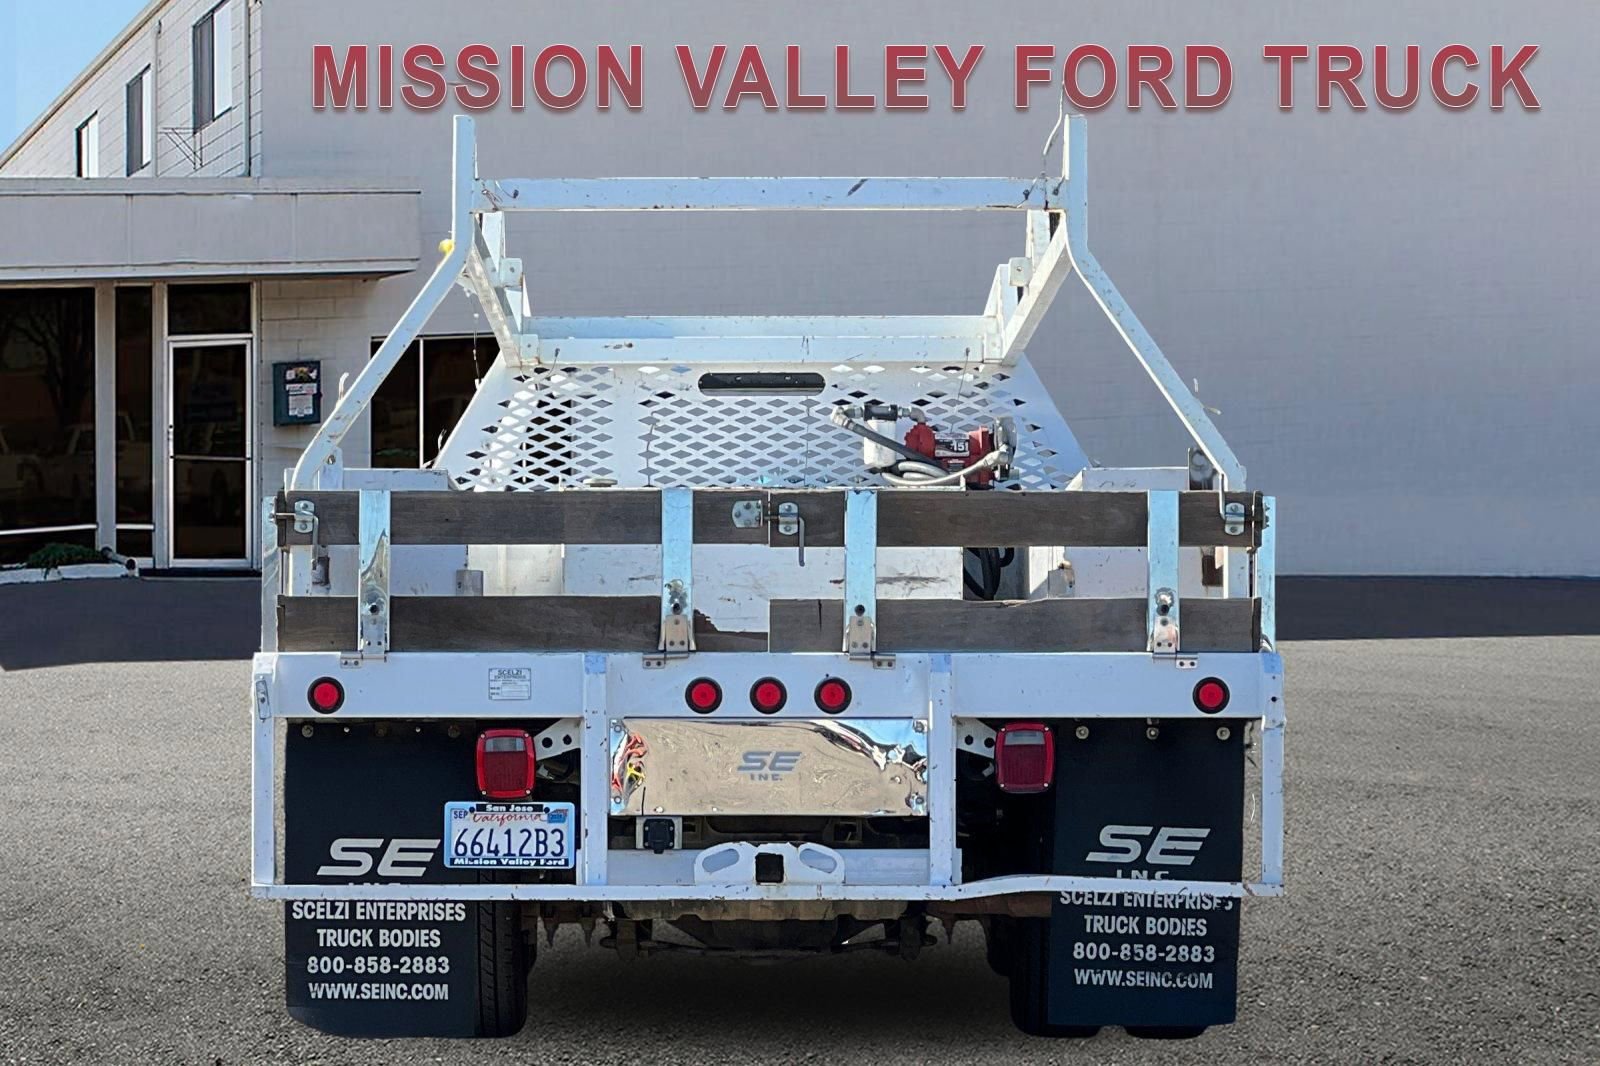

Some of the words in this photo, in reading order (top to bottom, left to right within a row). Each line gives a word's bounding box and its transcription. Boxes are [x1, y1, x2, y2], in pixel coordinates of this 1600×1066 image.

[737, 751, 802, 772] SE
[453, 810, 469, 819] SEP
[485, 804, 507, 812] San
[509, 804, 534, 812] Jose
[472, 813, 548, 827] California
[454, 828, 565, 857] 66412B3
[1085, 824, 1211, 866] SE
[316, 838, 442, 877] SE
[500, 858, 537, 867] Valley
[1060, 891, 1117, 907] SCELZI
[292, 901, 350, 920] SCELZI
[355, 902, 467, 921] ENTERPRISES
[1084, 914, 1140, 935] TRUCK
[1145, 917, 1208, 937] BODIES
[316, 928, 374, 947] TRUCK
[379, 929, 441, 947] BODIES
[1073, 941, 1215, 963] 800-858-2883
[306, 956, 450, 974] 800-858-2883
[1074, 968, 1214, 989] WWW.SEINC.COM
[308, 982, 449, 1000] WWW.SEINC.COM
